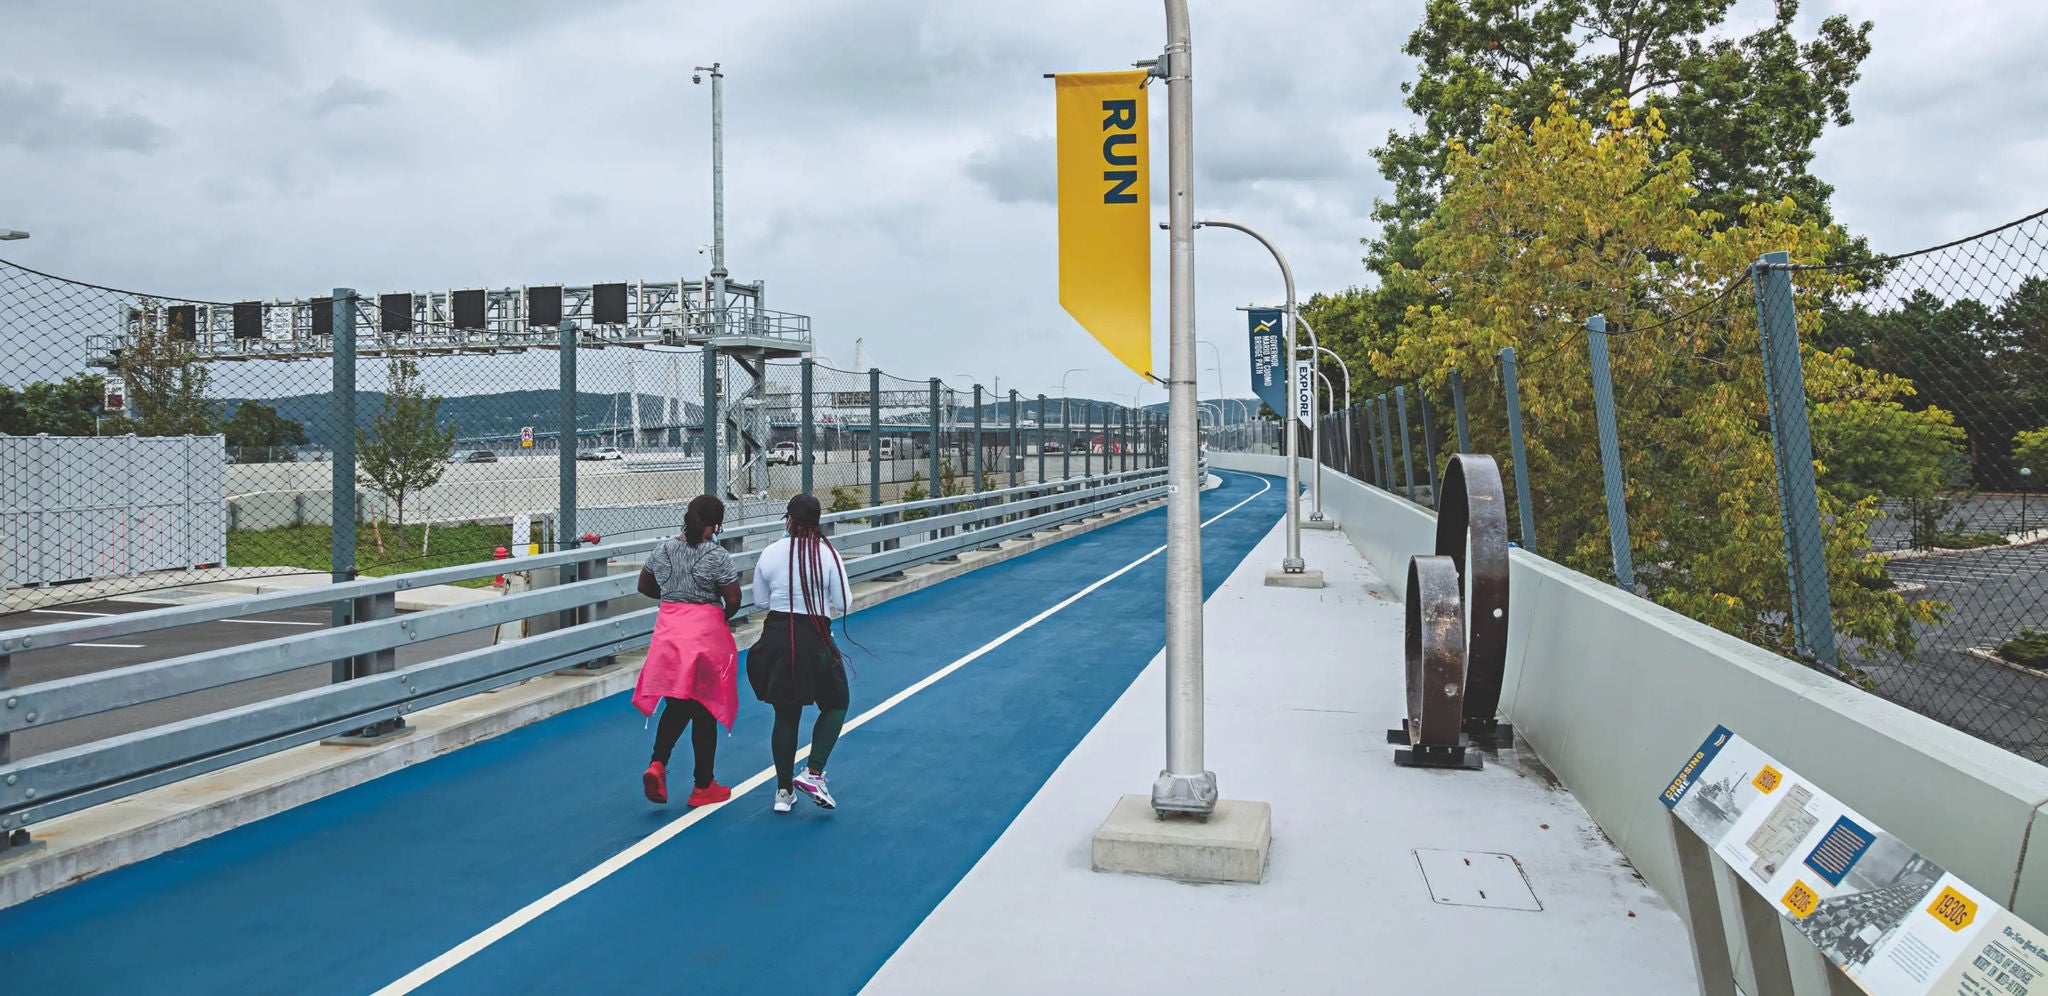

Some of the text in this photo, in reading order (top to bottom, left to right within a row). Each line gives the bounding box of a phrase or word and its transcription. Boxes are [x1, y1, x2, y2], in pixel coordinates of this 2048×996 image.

[1102, 99, 1138, 204] RUN
[1254, 336, 1264, 375] BRIDGE PATH
[1262, 335, 1271, 355] MARIO
[1269, 335, 1279, 367] GOVERNOR
[1263, 364, 1272, 387] CUOMO
[1299, 366, 1309, 417] EXPLORE
[1665, 751, 1705, 798] CROSSING
[1669, 779, 1691, 802] TIME
[1787, 885, 1812, 913] 1920s
[1935, 893, 1968, 926] 1930s
